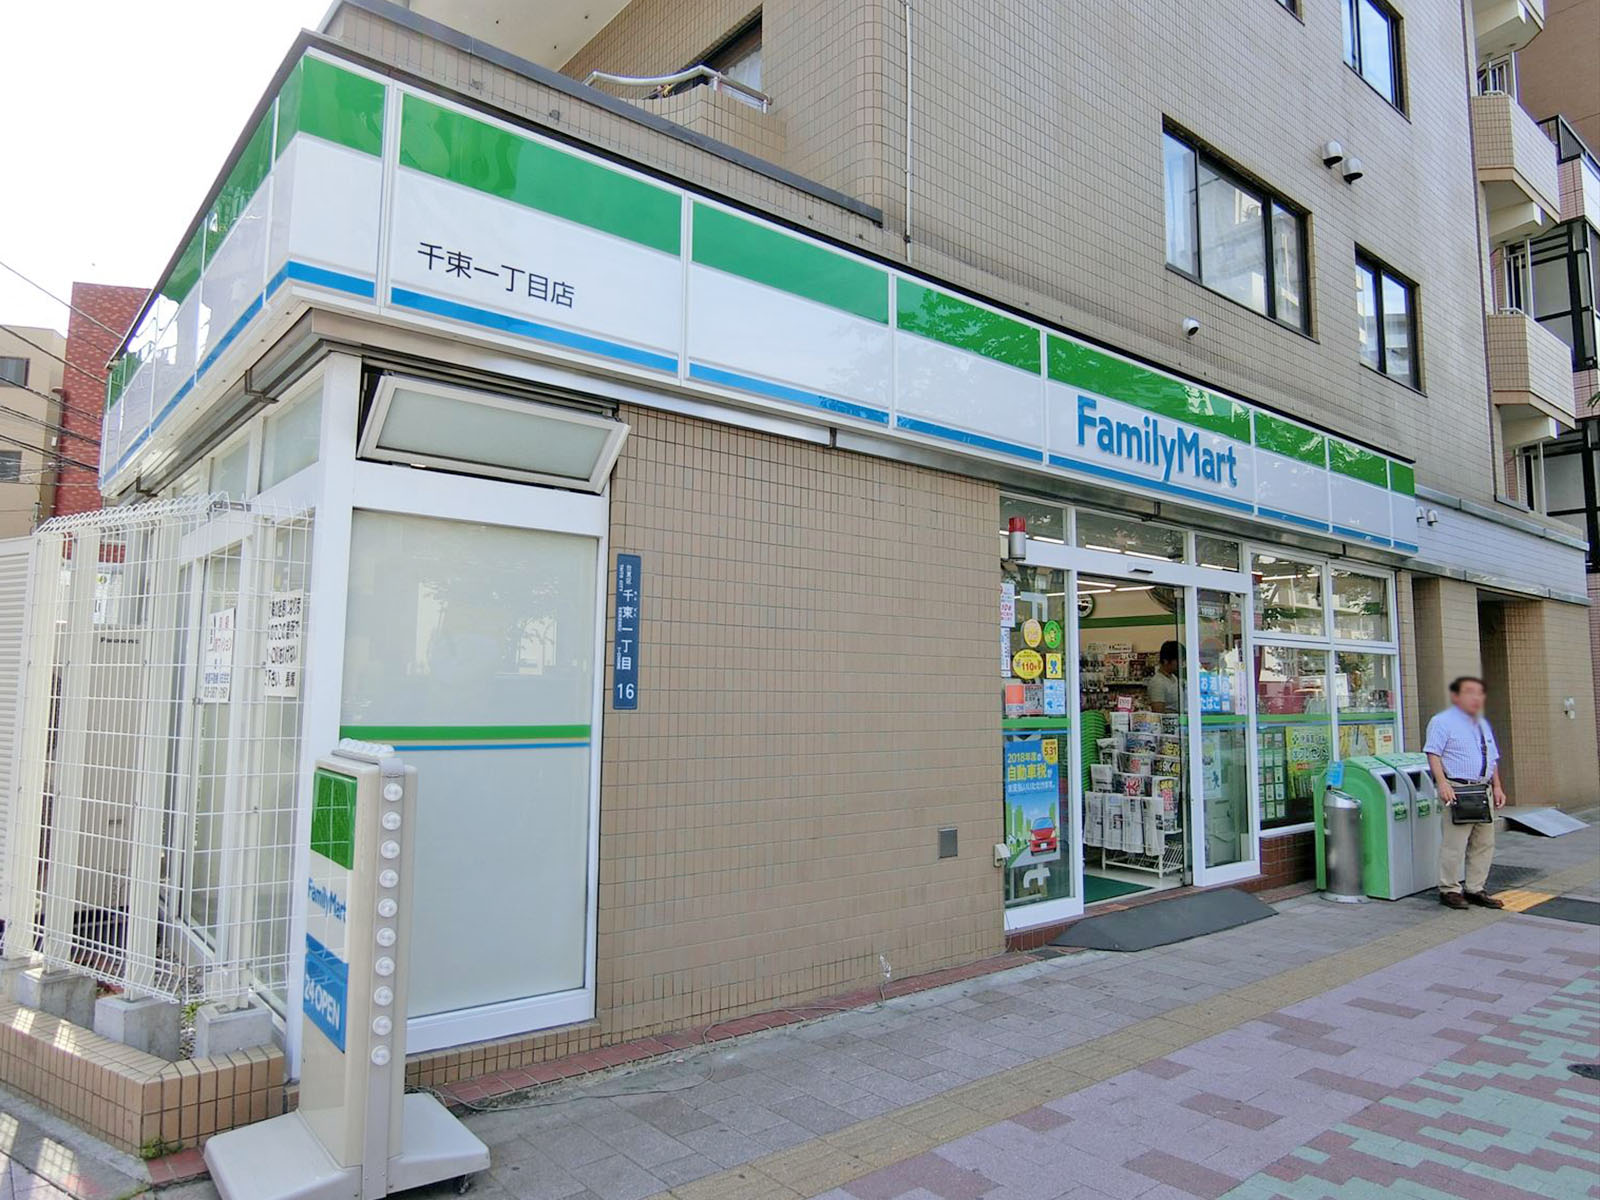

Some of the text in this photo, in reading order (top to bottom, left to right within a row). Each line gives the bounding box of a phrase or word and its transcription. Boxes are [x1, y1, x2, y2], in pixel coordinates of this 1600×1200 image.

[417, 242, 575, 309] 千束一丁目店
[1077, 395, 1238, 488] FamilyMart
[617, 683, 635, 699] 16
[307, 876, 347, 923] FamilyMart
[315, 984, 341, 1031] OPEN
